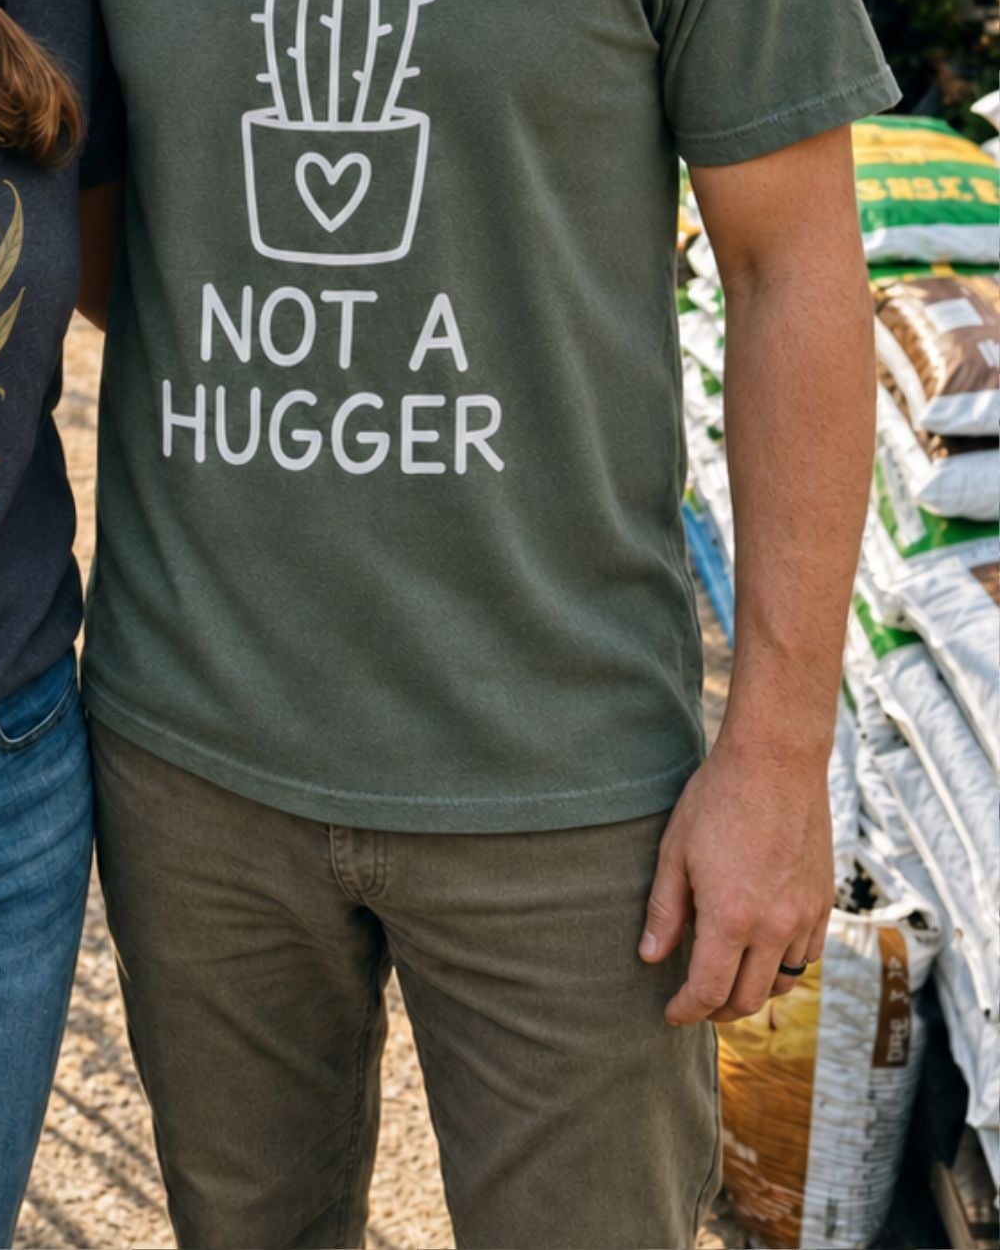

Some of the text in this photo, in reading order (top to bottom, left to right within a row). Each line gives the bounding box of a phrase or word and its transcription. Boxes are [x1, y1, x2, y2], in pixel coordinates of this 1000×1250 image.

[200, 282, 469, 372] NOT A
[162, 379, 505, 475] HUGGER
